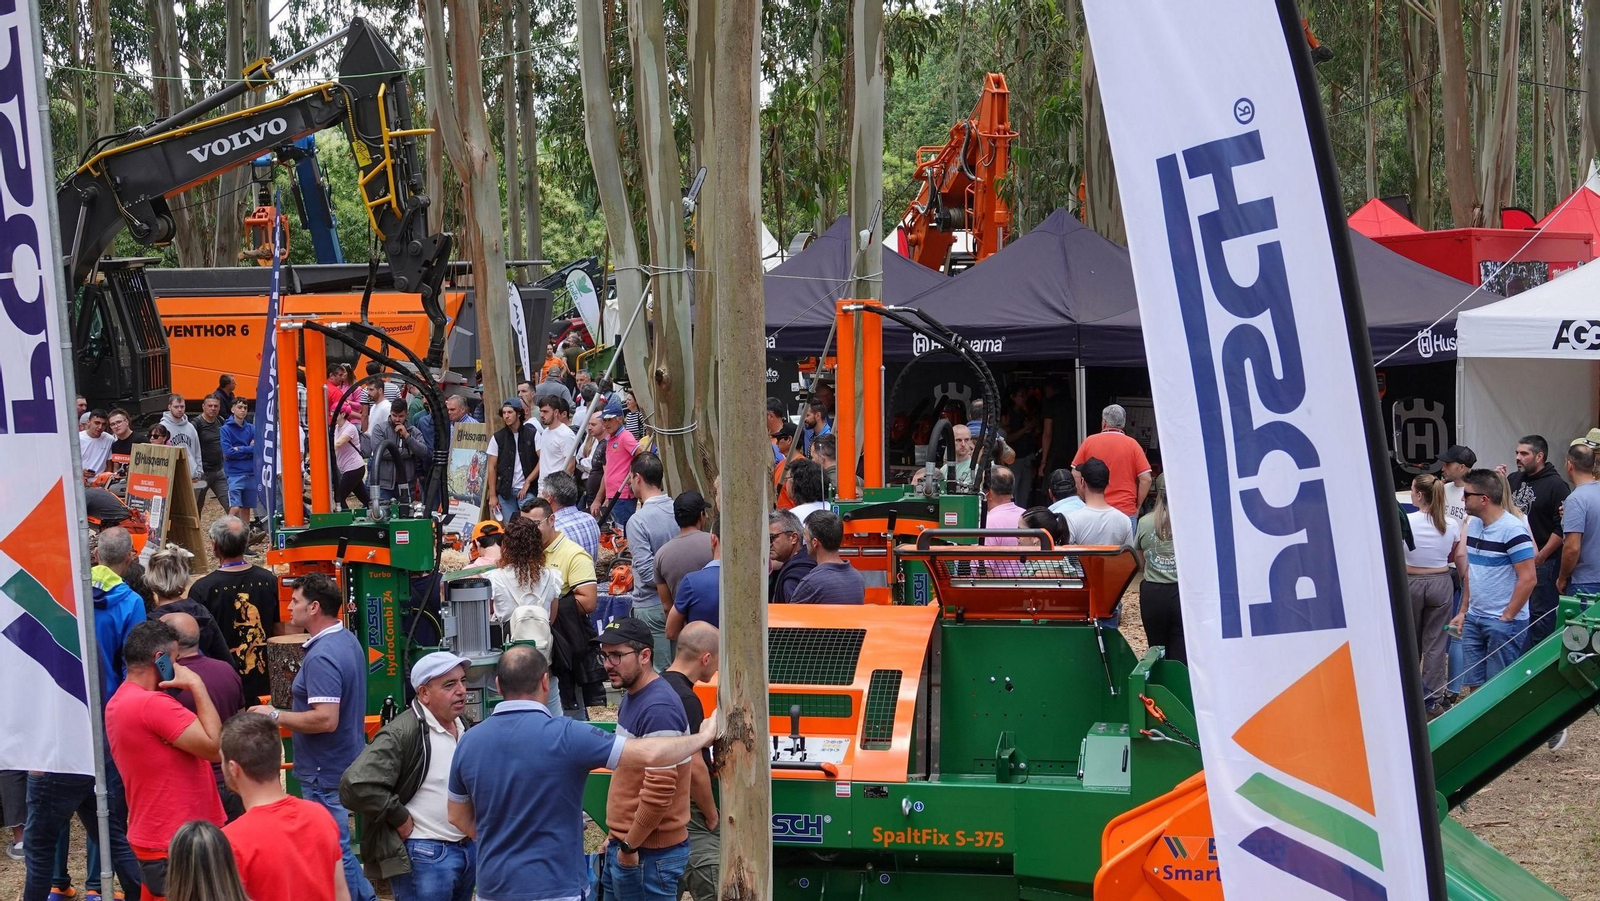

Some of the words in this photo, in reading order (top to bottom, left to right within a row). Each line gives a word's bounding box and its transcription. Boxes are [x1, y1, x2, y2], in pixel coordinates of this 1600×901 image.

[187, 117, 287, 162] VOLVO
[240, 324, 250, 336] 6
[141, 454, 169, 467] Husqvarna
[1450, 506, 1466, 519] BES
[383, 590, 393, 603] 24
[366, 598, 378, 646] POSCH
[384, 607, 399, 676] HydroCombi
[772, 814, 823, 835] SCH
[872, 827, 949, 847] SpaltFix
[955, 830, 1004, 847] S-375
